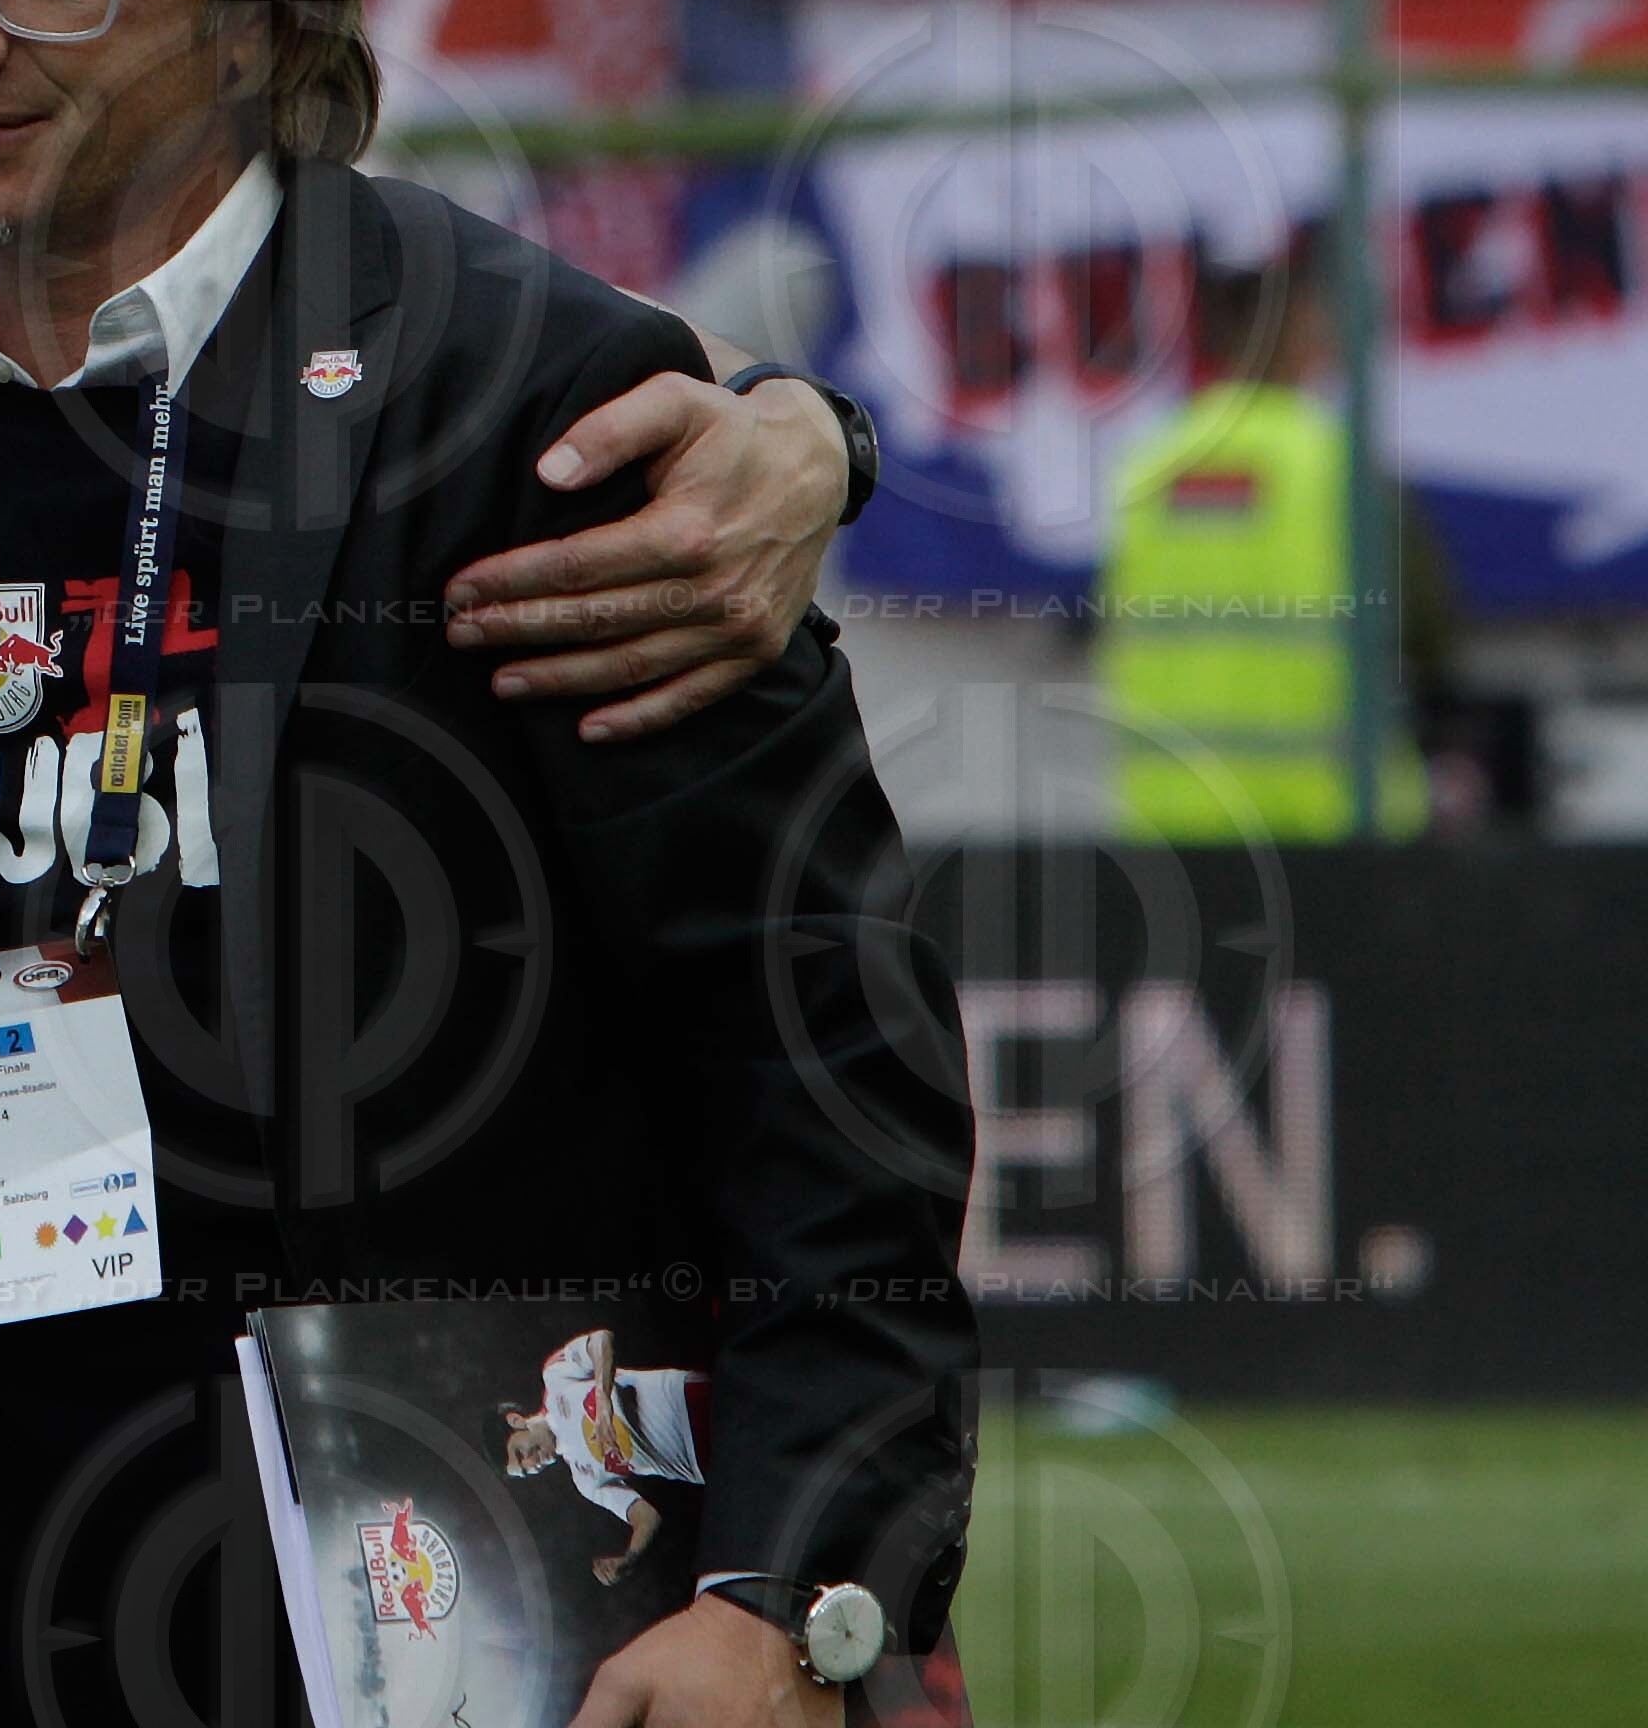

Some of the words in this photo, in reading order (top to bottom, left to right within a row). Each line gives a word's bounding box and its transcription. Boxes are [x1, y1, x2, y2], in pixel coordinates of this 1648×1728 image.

[145, 455, 167, 512] man
[134, 517, 160, 588] spürt
[124, 592, 150, 647] Live
[6, 1029, 24, 1053] 2
[3, 1190, 50, 1207] Salzburg
[91, 1252, 134, 1280] VIP
